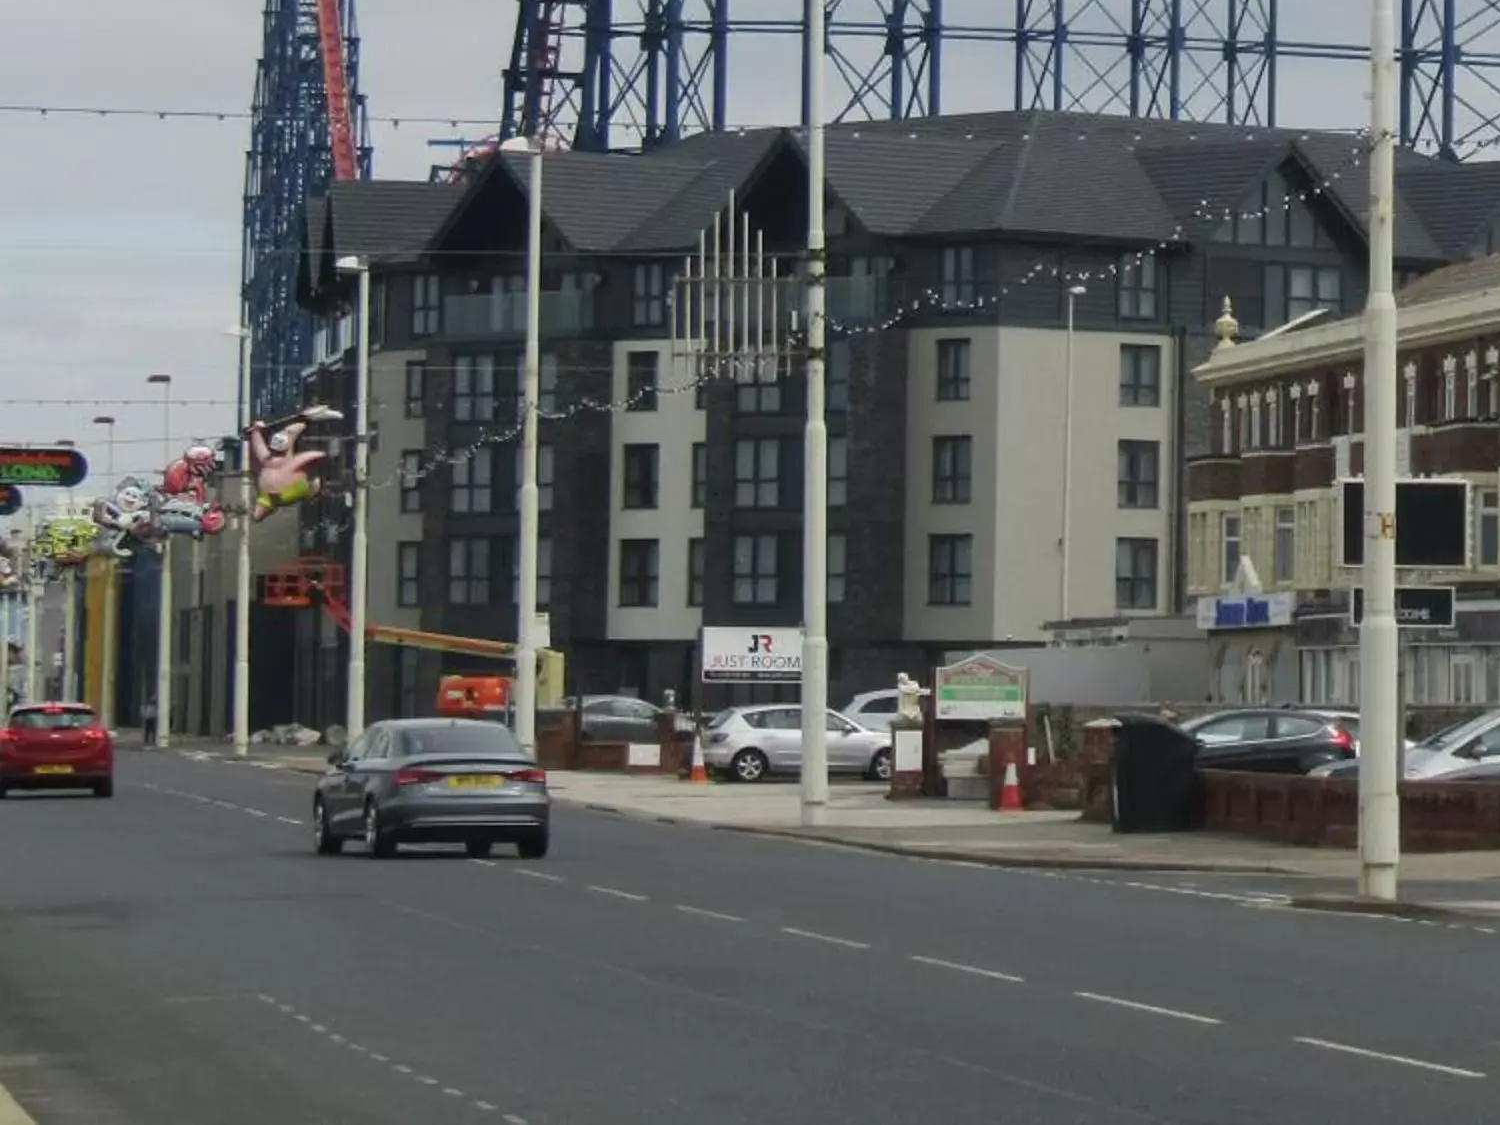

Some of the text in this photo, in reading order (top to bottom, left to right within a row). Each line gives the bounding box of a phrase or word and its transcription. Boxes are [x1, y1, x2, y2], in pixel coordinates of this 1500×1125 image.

[748, 634, 773, 653] JR
[710, 655, 802, 669] JUST ROOM
